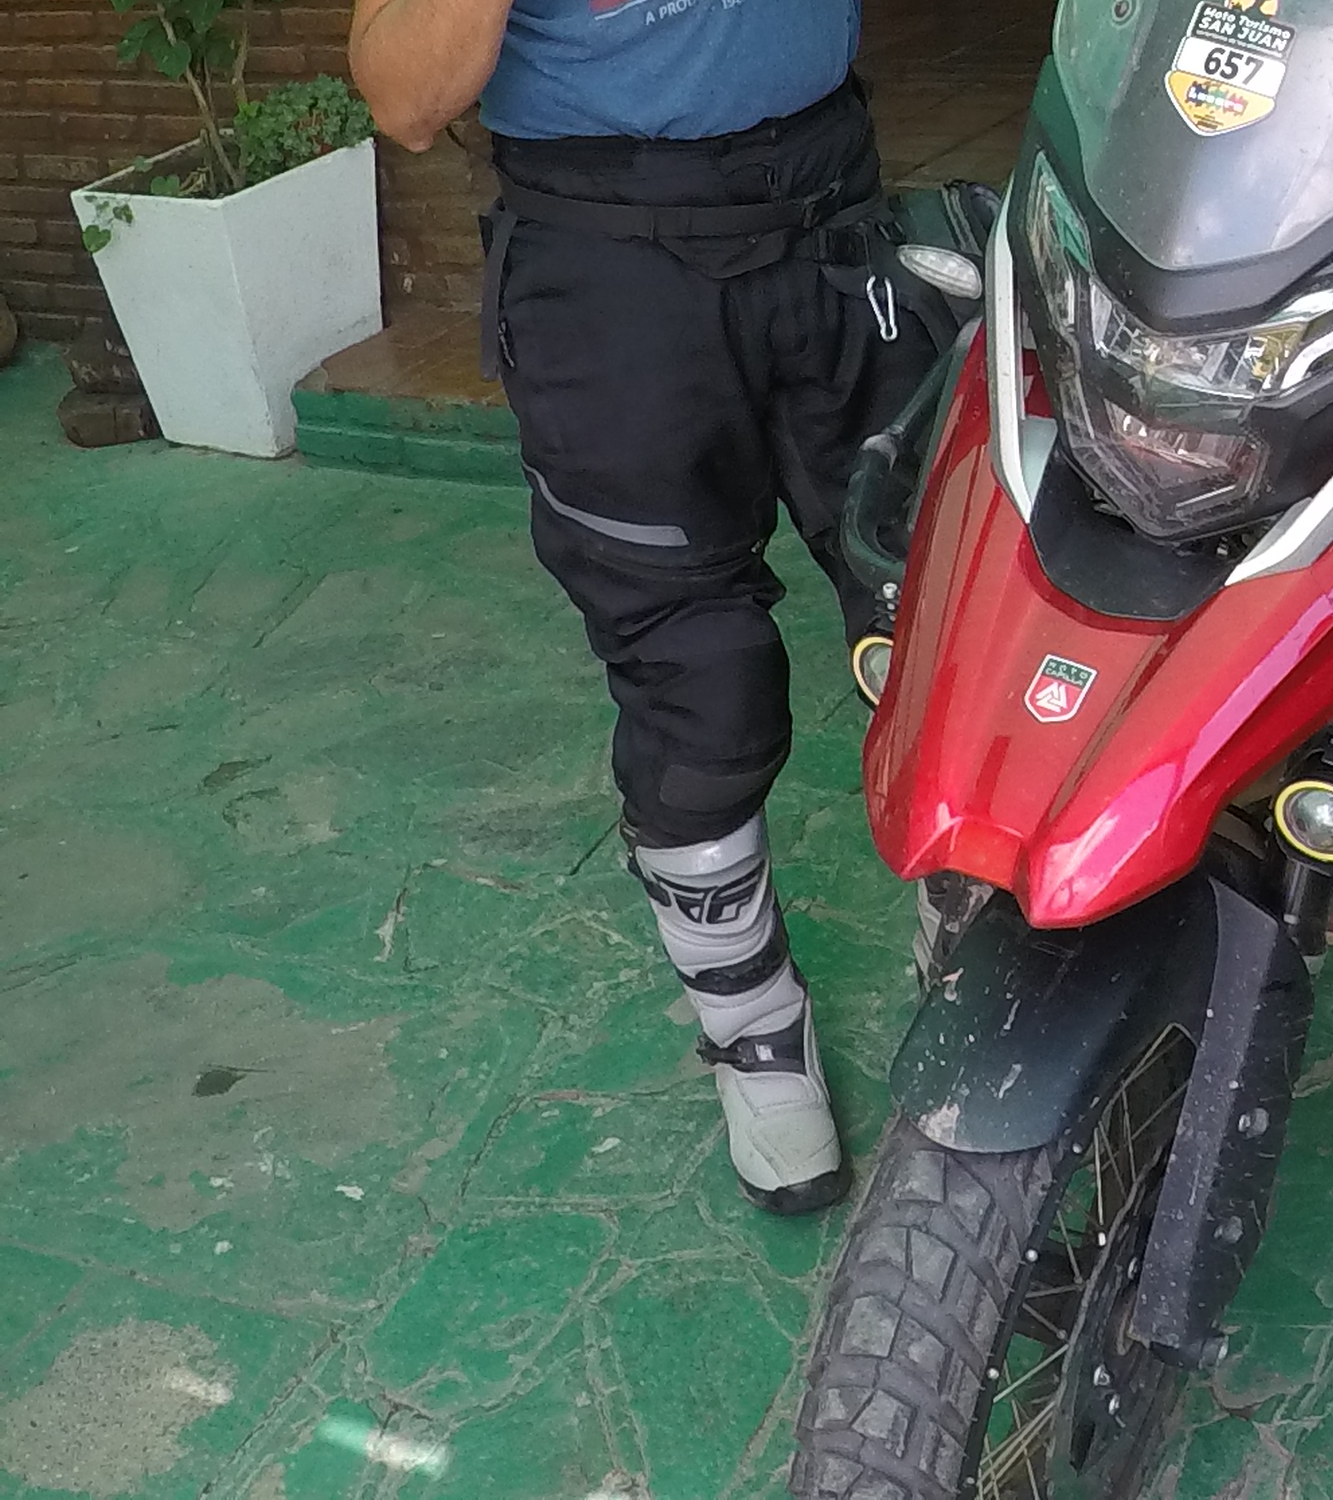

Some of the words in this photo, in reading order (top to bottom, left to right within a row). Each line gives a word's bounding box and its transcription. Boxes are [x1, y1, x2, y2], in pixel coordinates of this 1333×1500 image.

[645, 11, 656, 26] A
[1204, 7, 1236, 23] Moto
[1199, 17, 1236, 36] SAN
[1237, 28, 1287, 51] JUAN
[1204, 47, 1265, 86] 657
